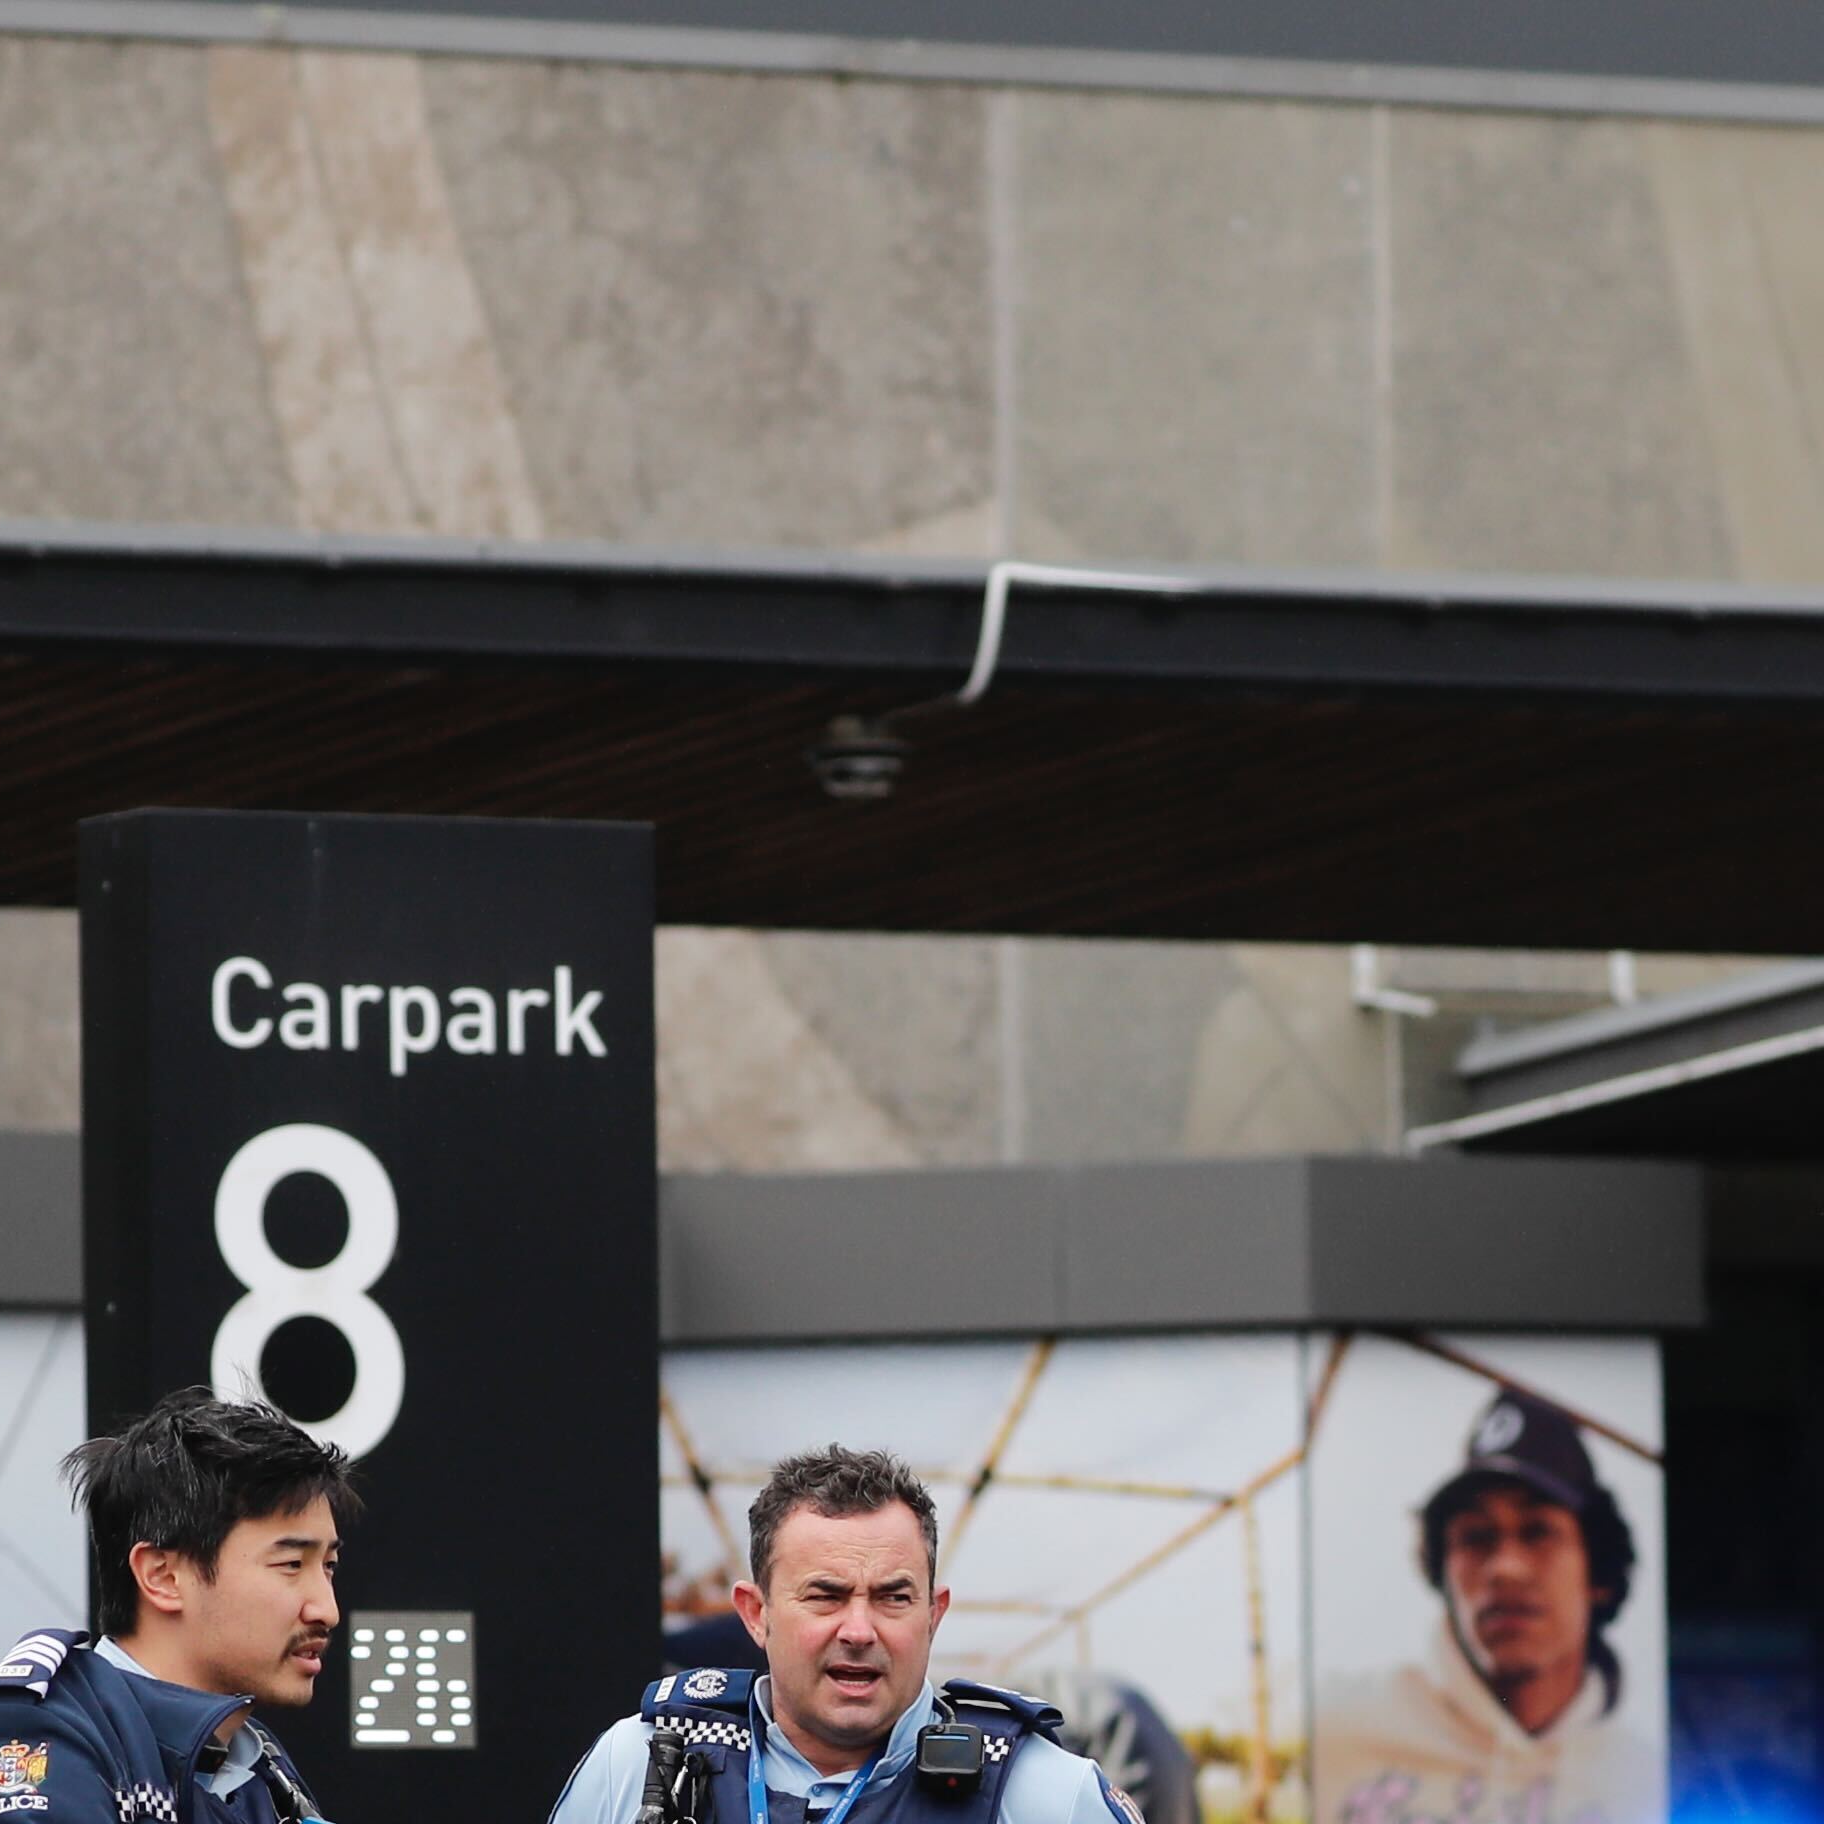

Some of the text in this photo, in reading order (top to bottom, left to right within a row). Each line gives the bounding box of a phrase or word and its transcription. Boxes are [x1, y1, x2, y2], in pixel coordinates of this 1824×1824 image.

[212, 956, 607, 1076] Carpark
[210, 1123, 405, 1463] 8
[350, 1628, 472, 1743] 26
